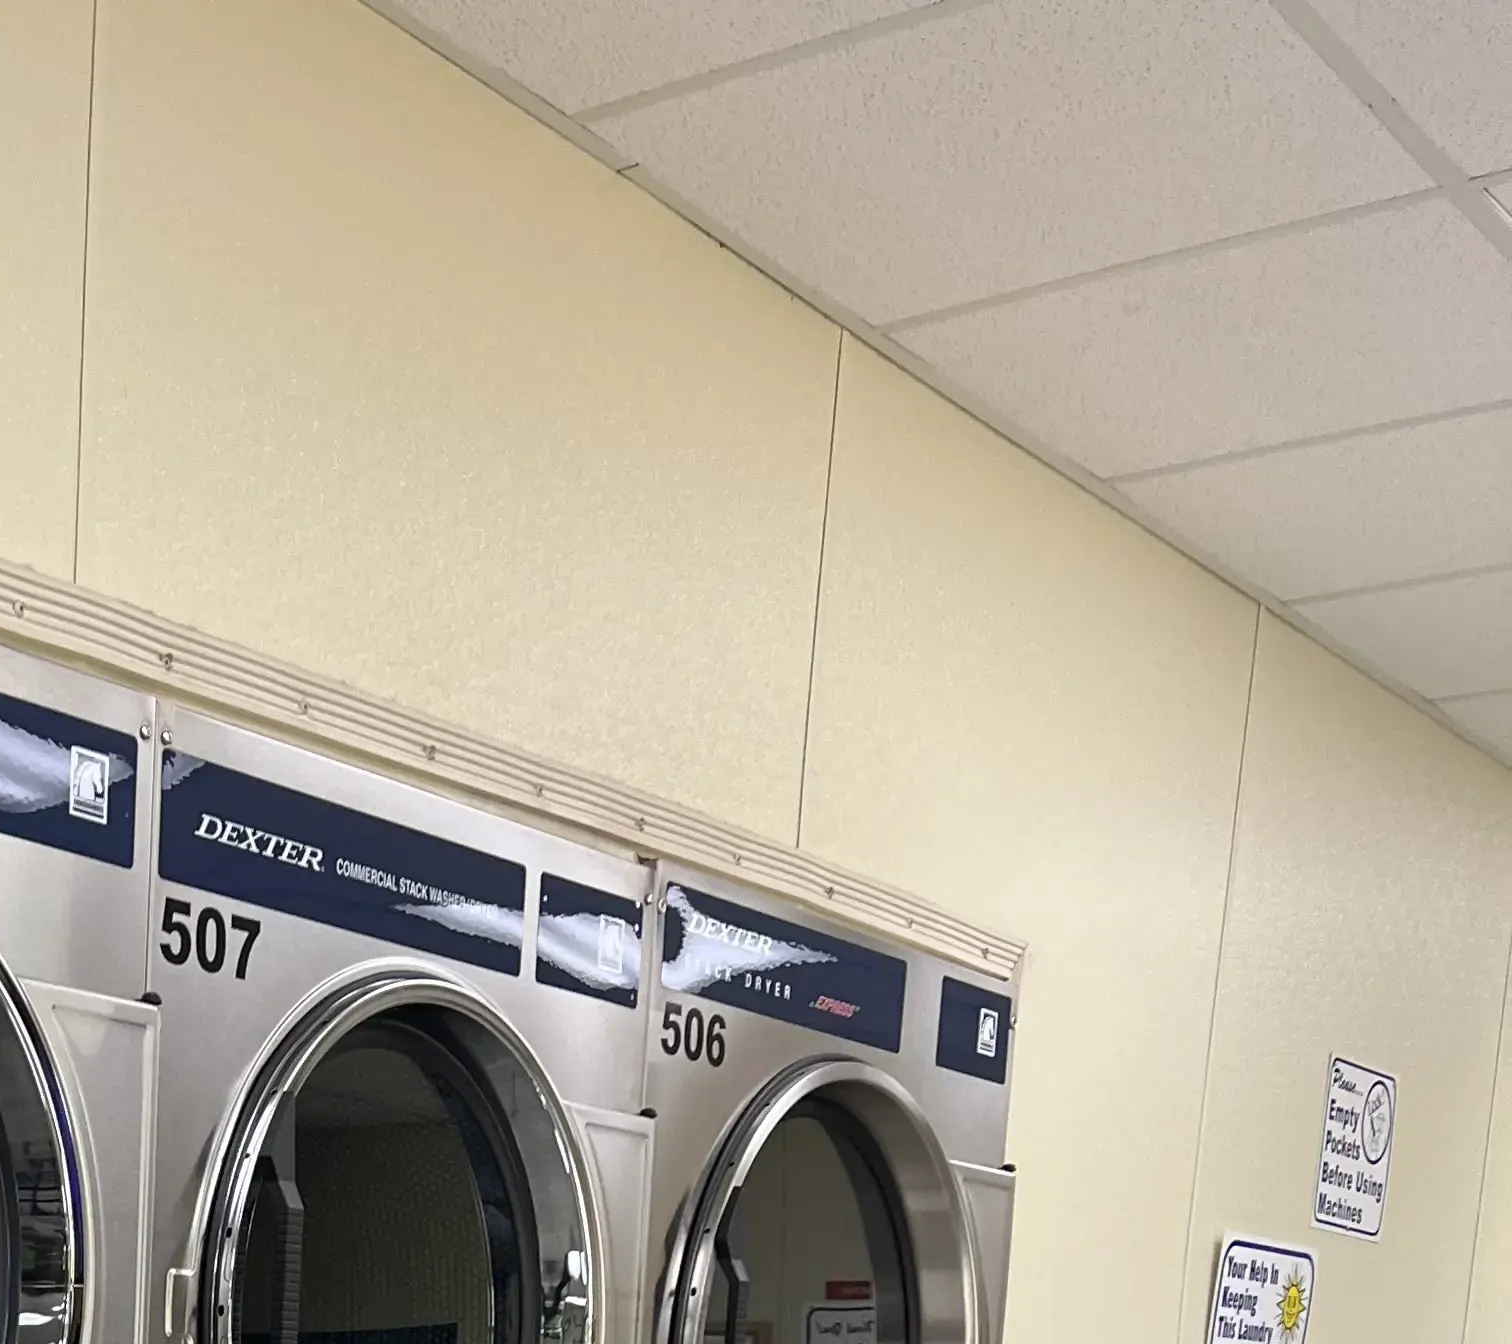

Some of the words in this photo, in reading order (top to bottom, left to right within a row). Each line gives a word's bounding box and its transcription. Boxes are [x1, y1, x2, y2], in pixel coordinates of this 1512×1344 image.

[194, 813, 323, 872] DEXTER
[336, 858, 397, 891] COMMERCIAL
[399, 878, 427, 900] STACK
[160, 896, 261, 980] 507
[688, 913, 773, 955] DEXTER
[745, 973, 791, 1000] DRYER
[661, 1001, 726, 1067] 506
[1329, 1098, 1360, 1133] Empty
[1325, 1130, 1360, 1160] Pockets
[1322, 1161, 1353, 1190] Before
[1356, 1171, 1383, 1203] Using
[1317, 1192, 1362, 1224] Machines
[1227, 1256, 1247, 1278] Your
[1249, 1259, 1268, 1288] Help
[1271, 1262, 1279, 1285] In
[1221, 1285, 1257, 1316] Keeping
[1217, 1316, 1235, 1339] This
